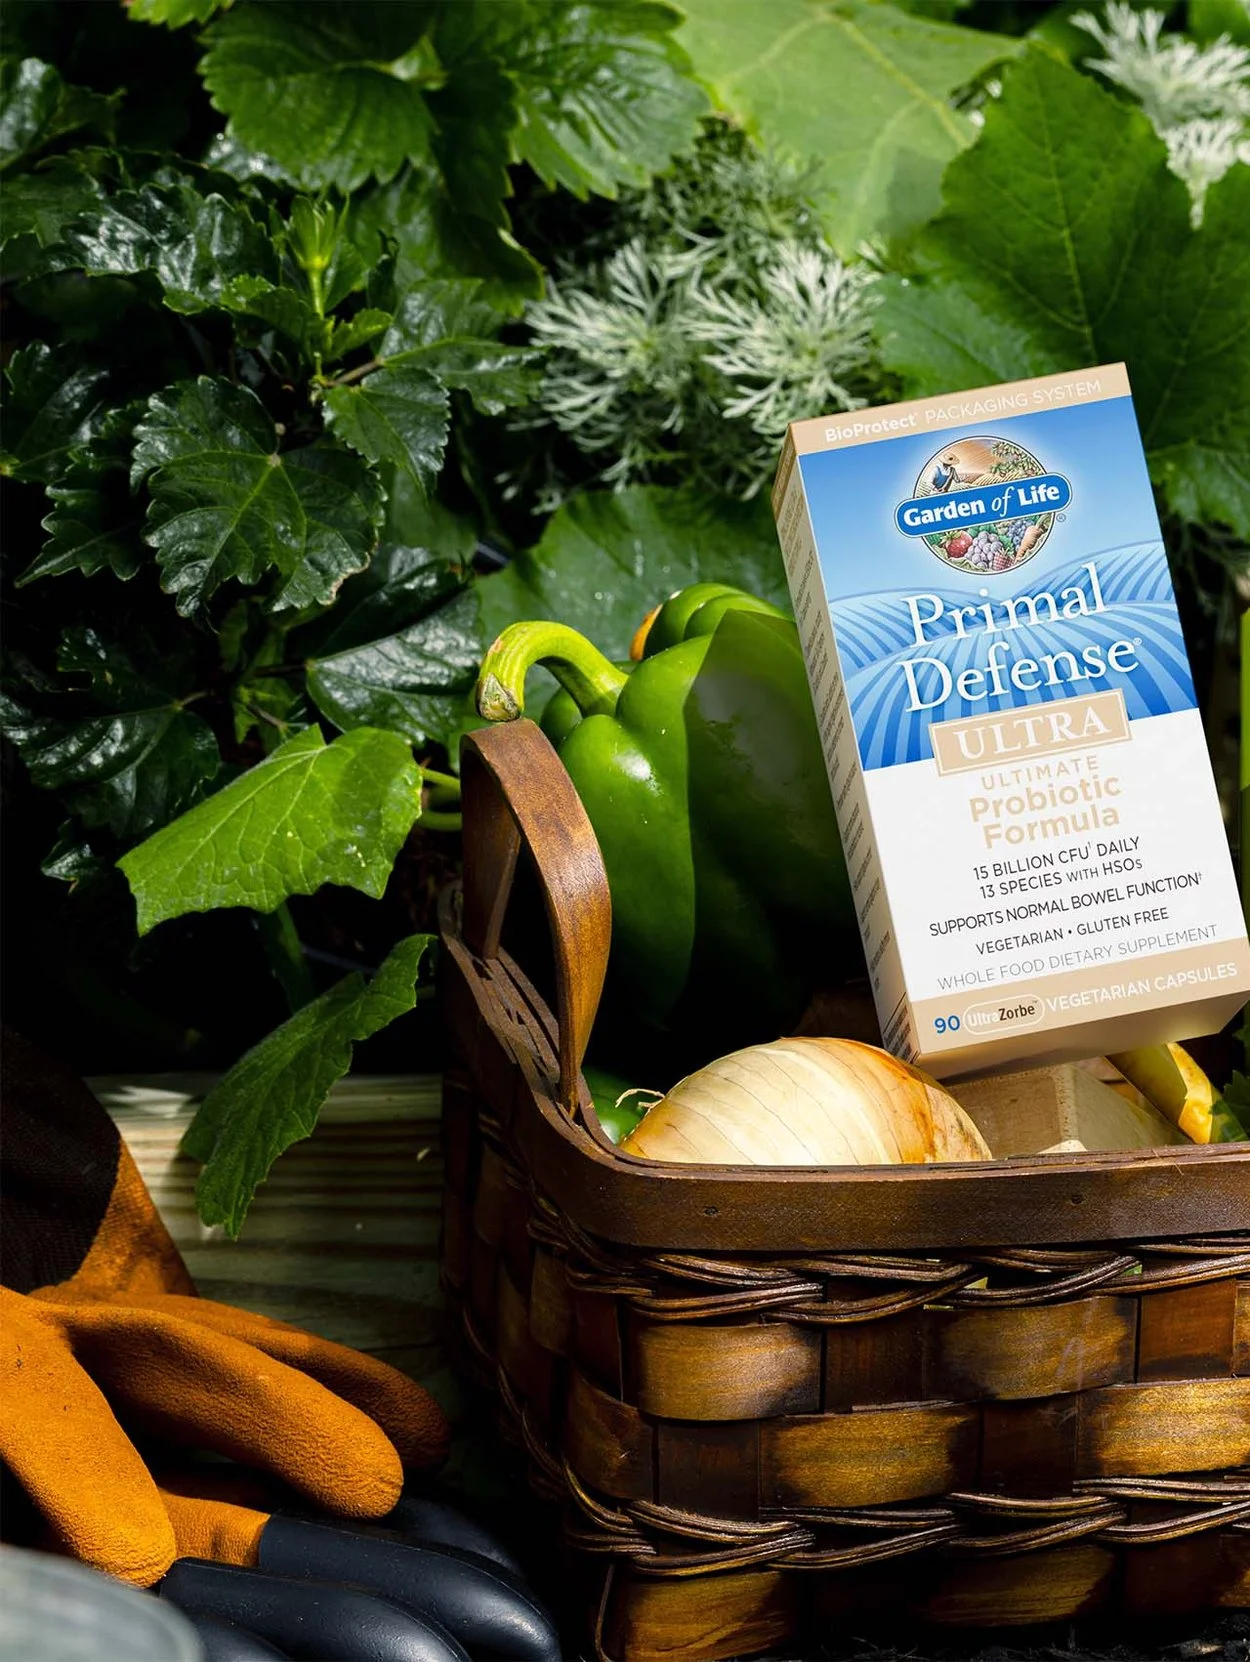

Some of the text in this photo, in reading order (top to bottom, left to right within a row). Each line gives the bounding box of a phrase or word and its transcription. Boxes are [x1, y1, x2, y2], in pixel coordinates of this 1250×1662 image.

[925, 391, 1029, 425] PACKAGING
[1032, 379, 1102, 404] SYSTEM
[903, 483, 1062, 527] Garden of Life
[899, 562, 1112, 649] Primal
[953, 706, 1112, 762] ULTRA
[981, 755, 1100, 791] ULTIMATE
[969, 773, 1122, 824] Probiotic
[982, 803, 1121, 850] Formula
[973, 864, 989, 880] 15
[992, 850, 1054, 878] BILLION
[1096, 836, 1141, 858] DAILY
[979, 885, 996, 900] 13
[999, 871, 1063, 896] SPECIES
[1066, 867, 1099, 884] WITH
[928, 908, 1004, 938] SUPPORTS
[1006, 894, 1070, 923] NORMAL
[1070, 885, 1125, 910] BOWEL
[976, 906, 1169, 956] VEGETARIAN GLUTEN FREE
[937, 923, 1218, 992] WHOLE FOOD DIETARY SUPPLEMENT
[933, 1015, 961, 1034] 90
[1045, 979, 1151, 1013] VEGETARIAN
[1153, 962, 1238, 993] CAPSULES
